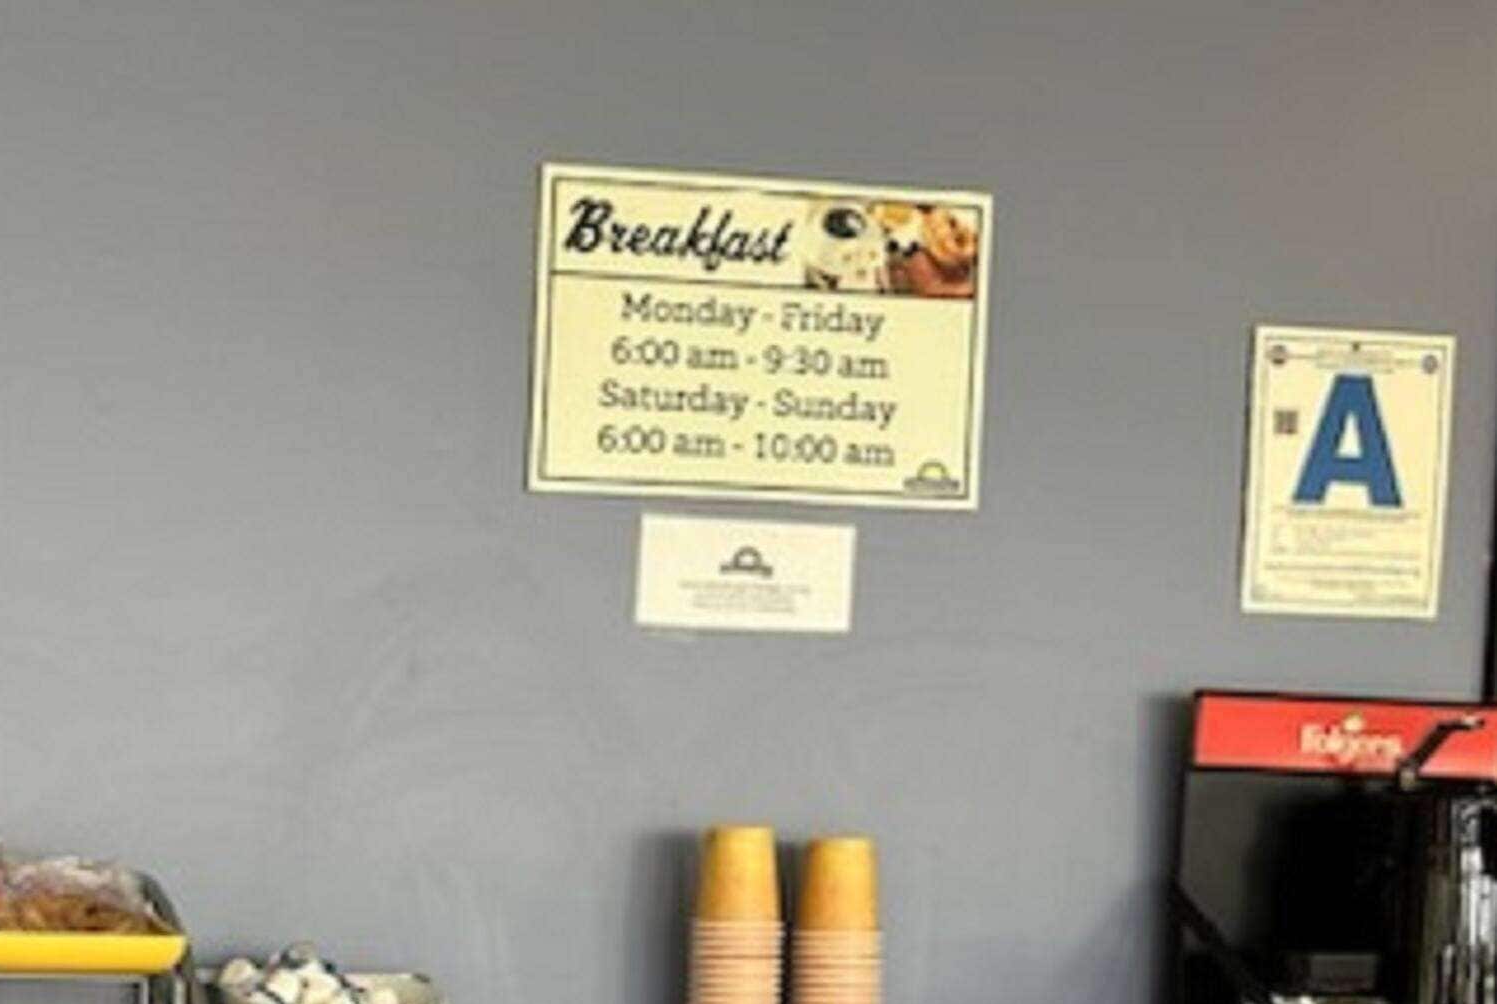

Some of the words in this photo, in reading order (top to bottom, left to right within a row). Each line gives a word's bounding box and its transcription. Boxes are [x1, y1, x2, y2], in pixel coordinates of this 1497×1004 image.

[564, 197, 793, 271] Breakfast
[620, 293, 757, 333] Monday
[780, 302, 886, 342] Friday
[610, 336, 680, 367] 6:00
[686, 345, 740, 371] am
[762, 345, 832, 375] 9:30
[837, 353, 889, 379] am
[598, 378, 751, 421] Saturday
[772, 389, 899, 429] Sunday
[596, 424, 667, 455] 6:00
[673, 433, 726, 459] am
[754, 433, 838, 464] 10:00
[843, 442, 896, 467] am
[1292, 374, 1402, 507] A
